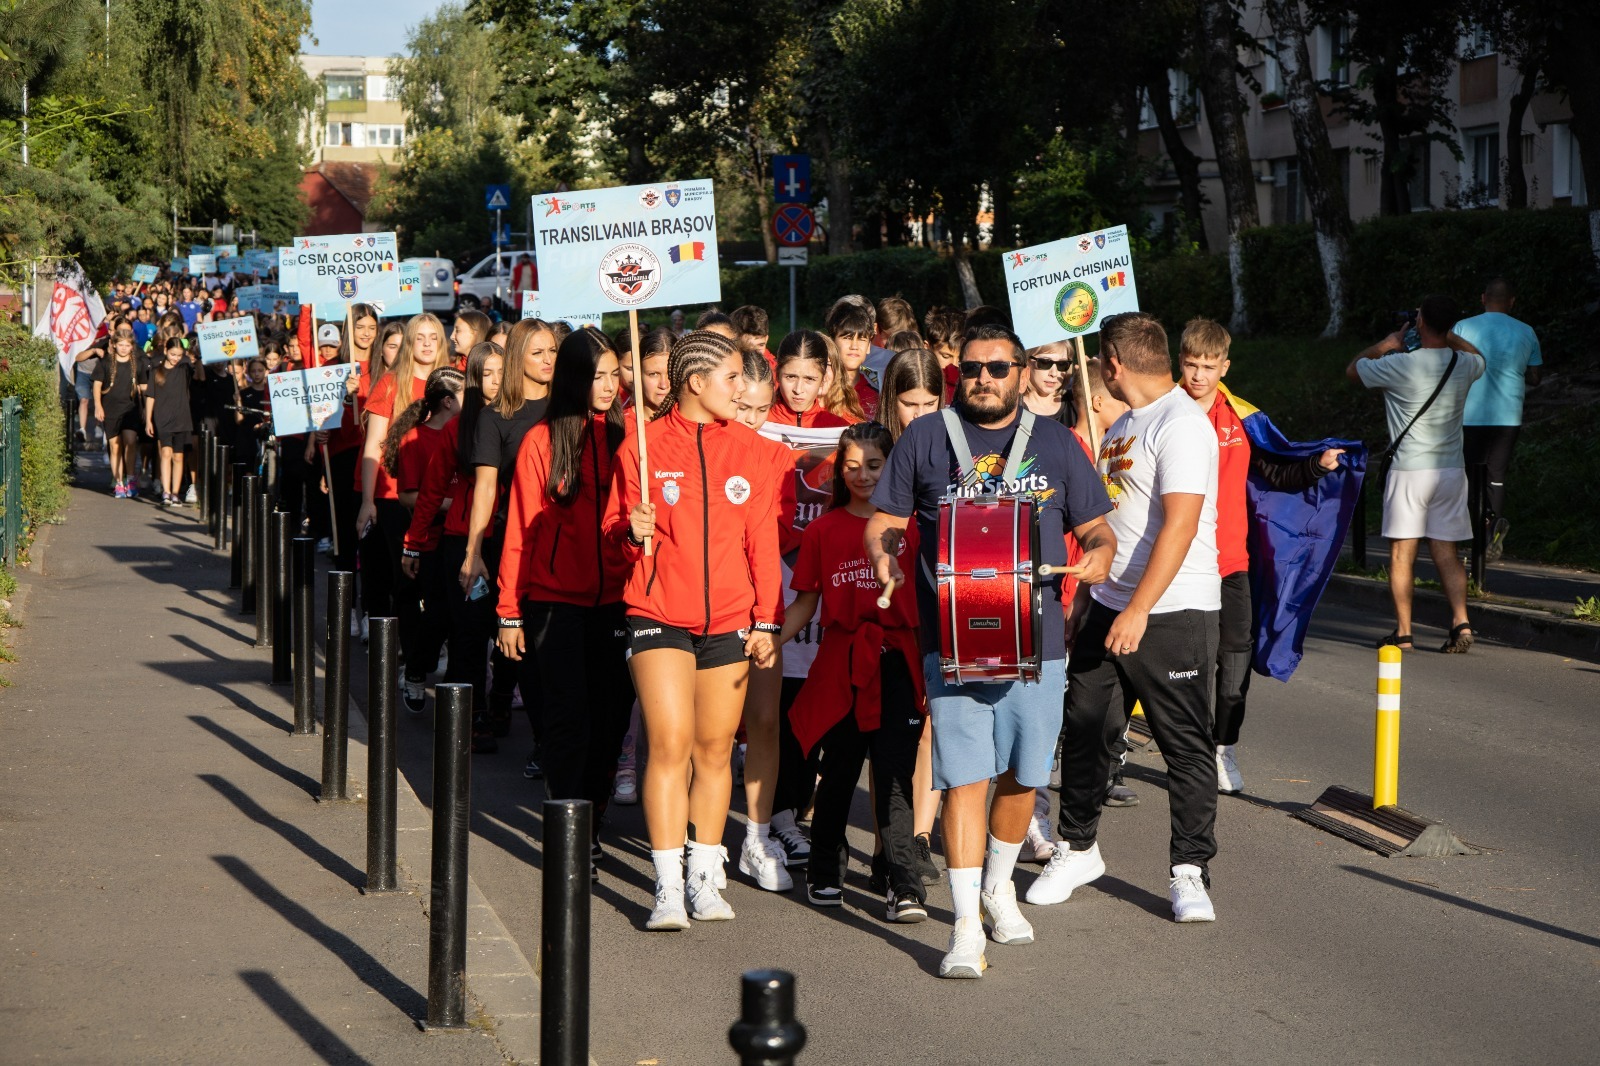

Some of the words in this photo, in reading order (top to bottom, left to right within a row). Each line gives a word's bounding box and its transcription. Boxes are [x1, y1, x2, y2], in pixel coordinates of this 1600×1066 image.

[540, 221, 648, 246] TRANSILVANIA
[651, 215, 714, 238] BRAȘOV
[298, 253, 328, 265] CSM
[332, 250, 394, 263] CORONA
[317, 263, 376, 276] BRASOV
[1012, 270, 1071, 293] FORTUNA
[1073, 255, 1129, 278] CHISINAU
[272, 387, 299, 399] ACS
[655, 470, 685, 479] Kempa
[634, 628, 662, 638] Kempa
[1168, 669, 1198, 680] Kempa
